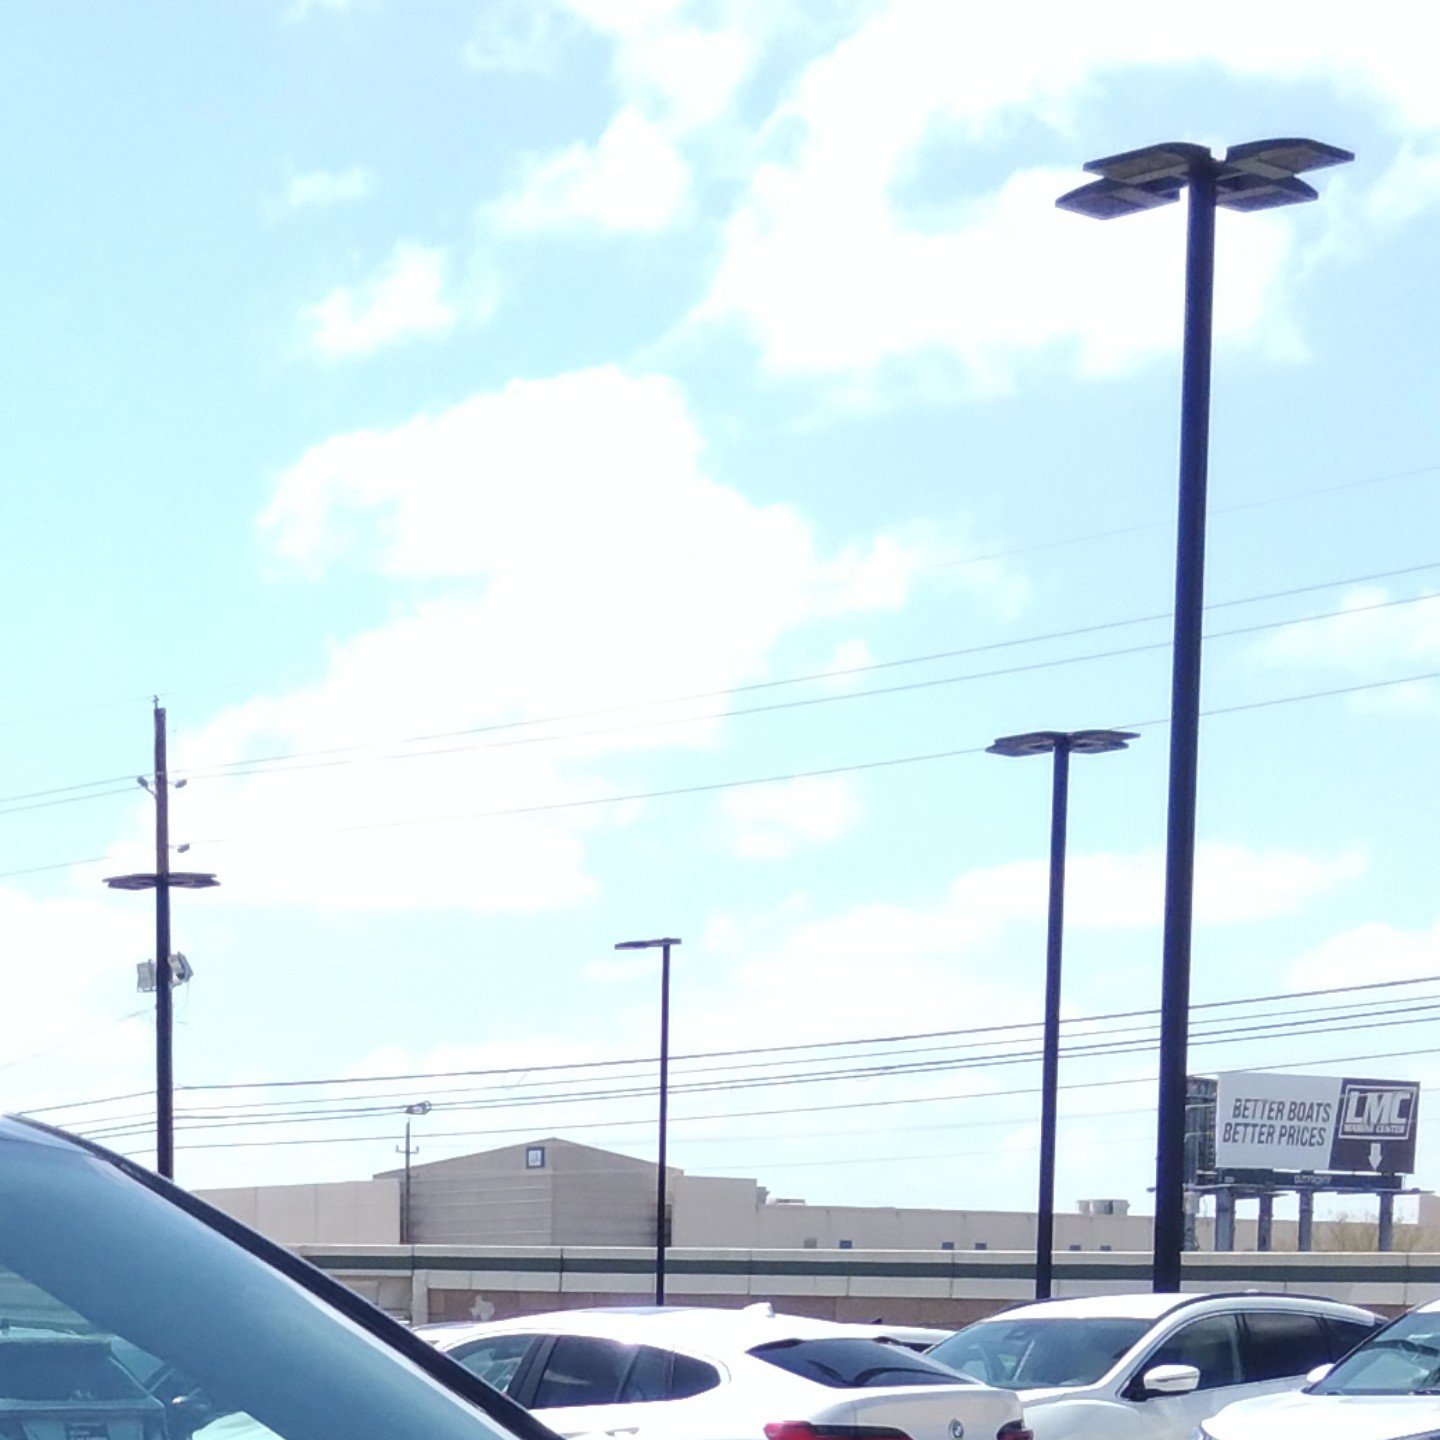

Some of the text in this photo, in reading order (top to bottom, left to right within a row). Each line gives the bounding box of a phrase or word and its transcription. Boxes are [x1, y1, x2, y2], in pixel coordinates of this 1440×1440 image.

[1232, 1098, 1331, 1122] BETTER BOATS
[1346, 1091, 1411, 1123] LMC
[1223, 1122, 1326, 1146] BETTER PRICES
